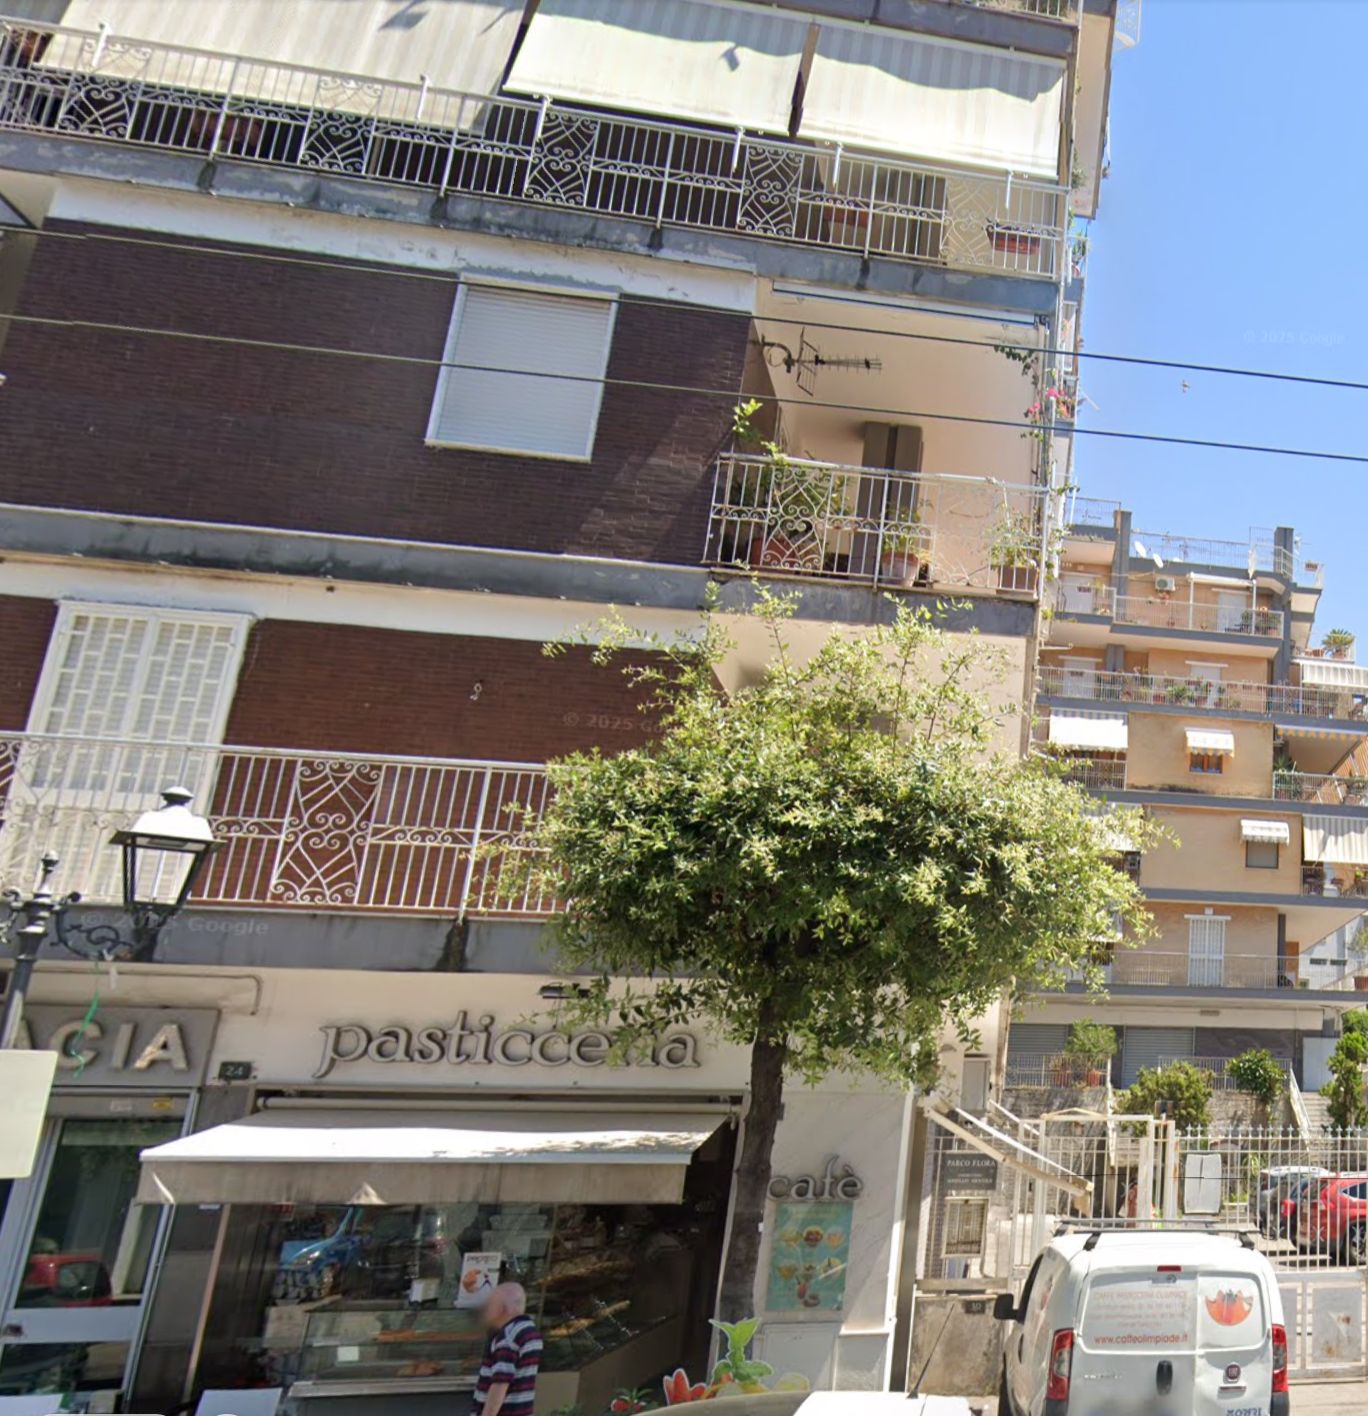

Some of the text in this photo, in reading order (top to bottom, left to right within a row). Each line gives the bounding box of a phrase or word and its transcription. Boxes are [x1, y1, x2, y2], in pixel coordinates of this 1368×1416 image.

[311, 1009, 702, 1079] pasticceia
[947, 1159, 996, 1167] PARCO FLORA
[767, 1155, 863, 1201] cafè
[1094, 1333, 1188, 1345] www.caffeolimpiade.it
